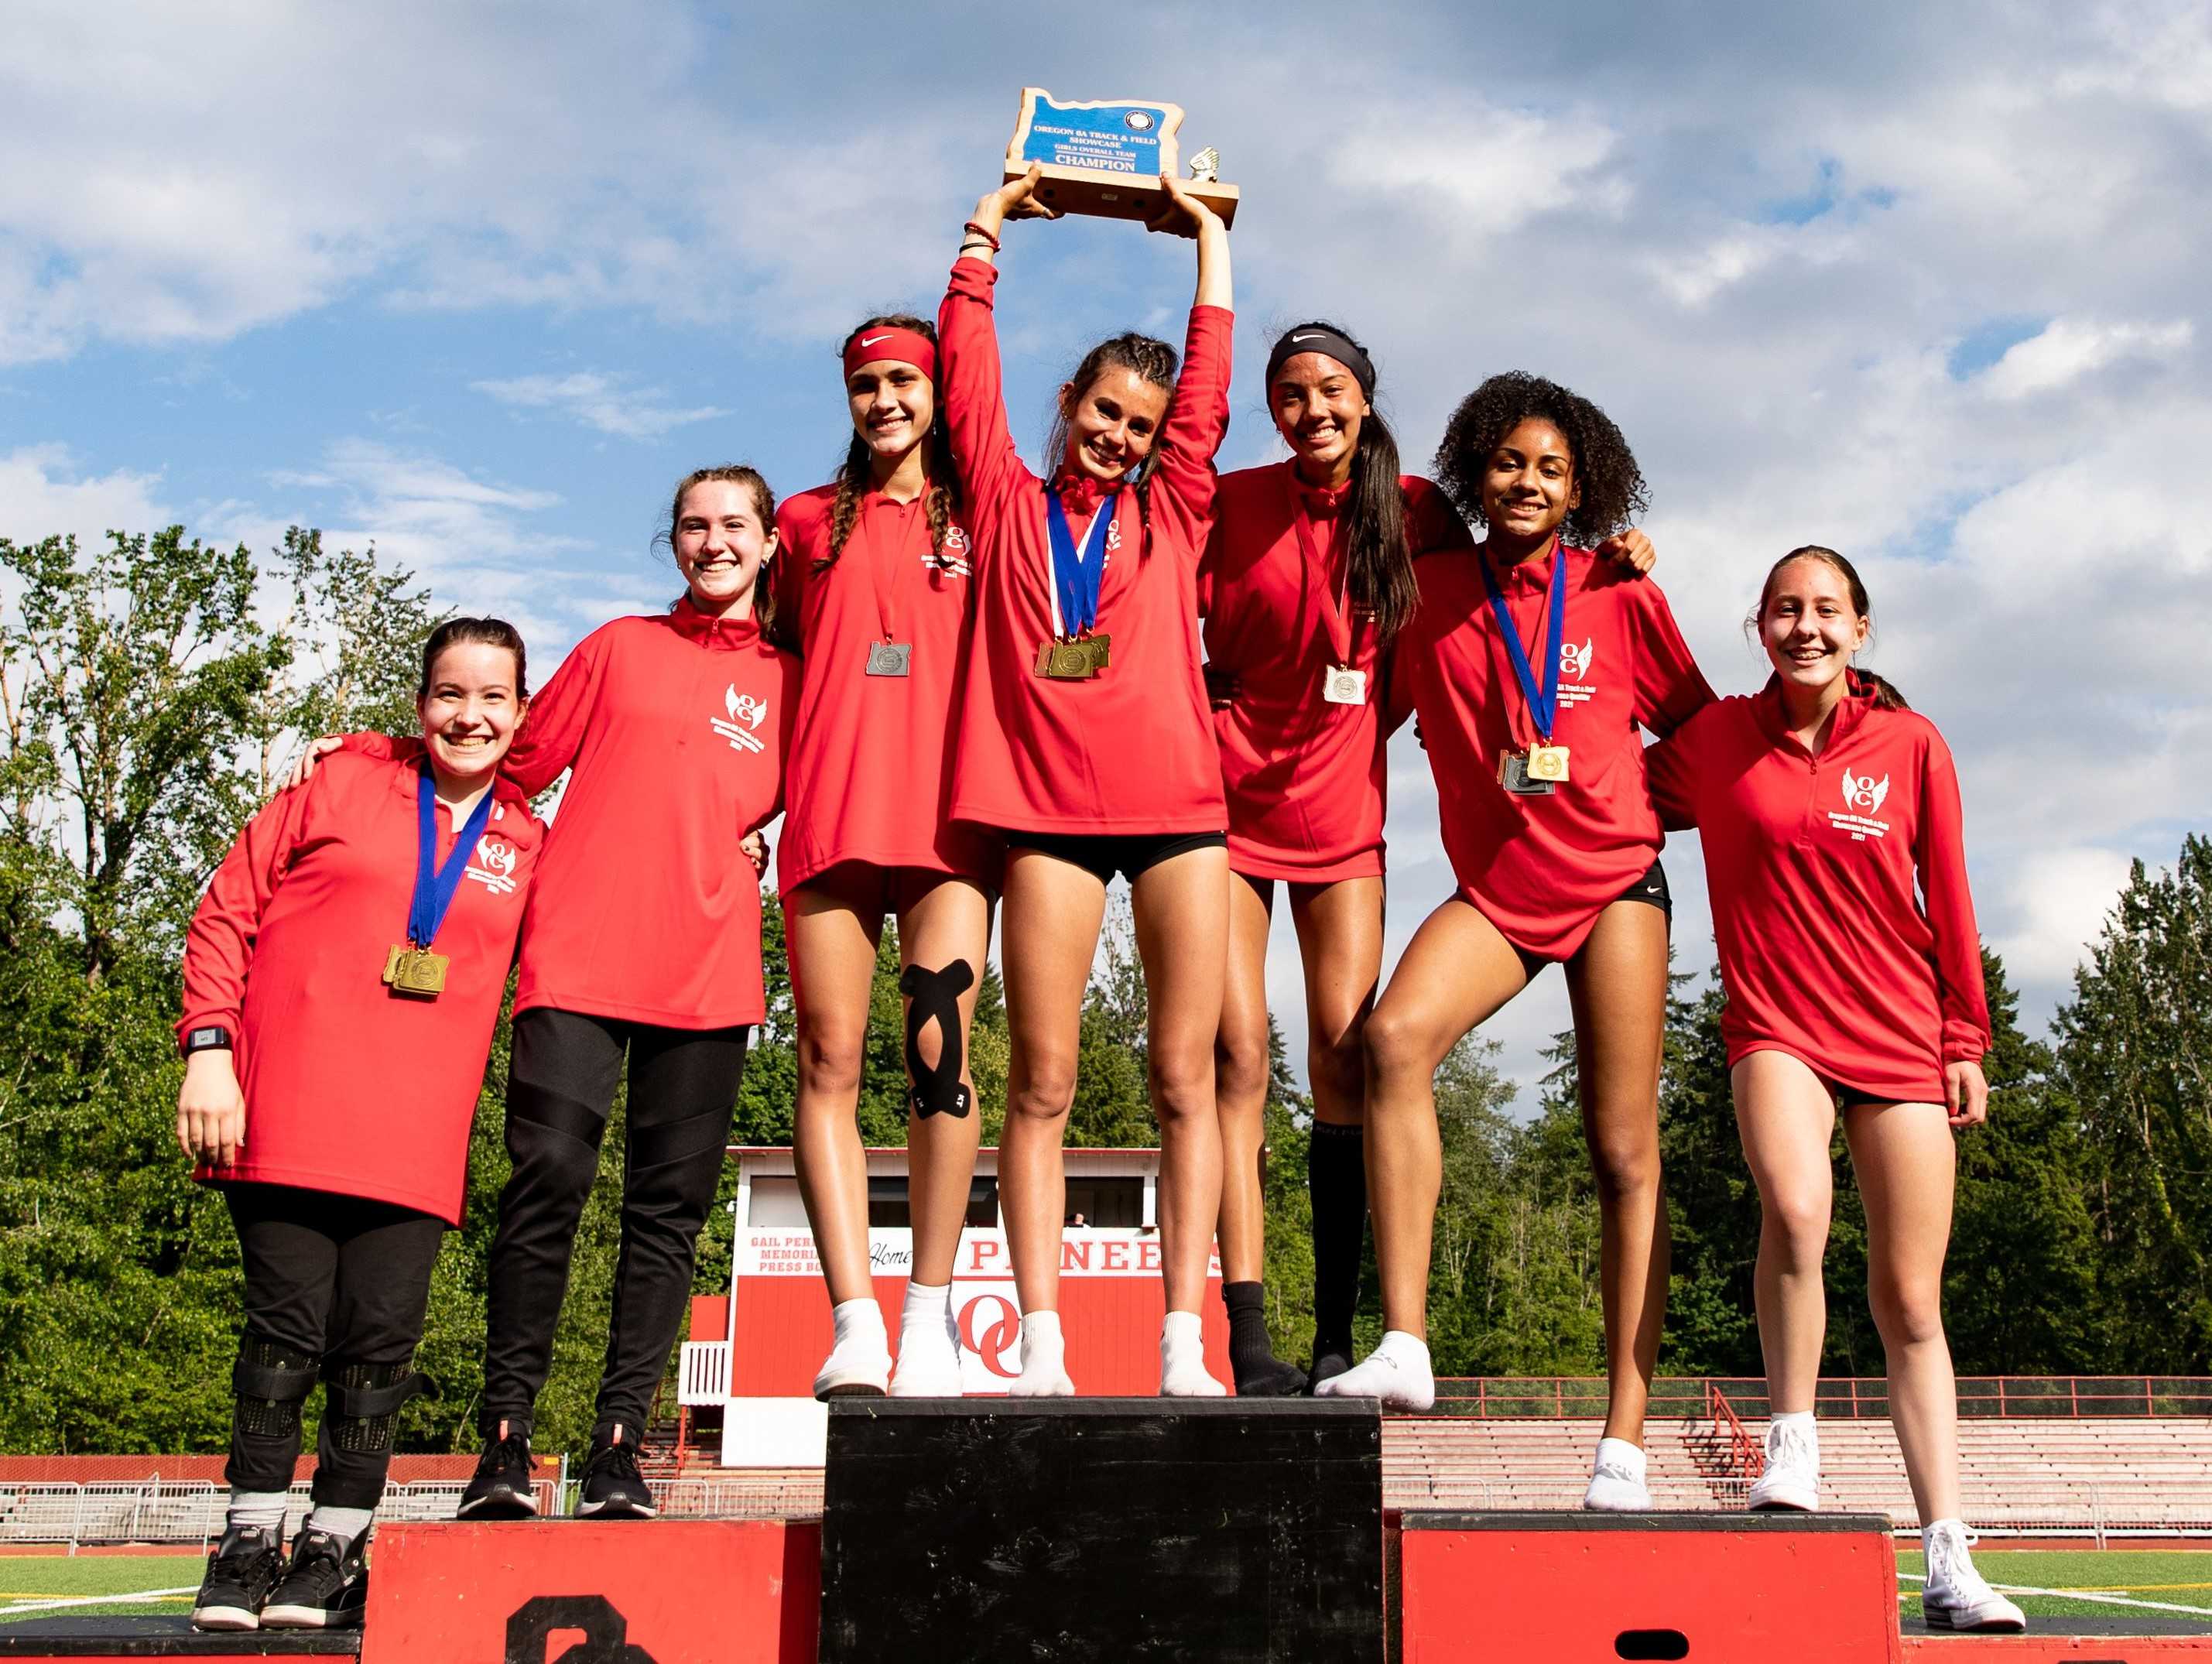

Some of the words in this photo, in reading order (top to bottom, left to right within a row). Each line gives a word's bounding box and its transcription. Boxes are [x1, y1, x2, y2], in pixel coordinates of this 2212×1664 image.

[1034, 125, 1073, 135] OREGON
[1089, 132, 1119, 141] TRACK
[1131, 136, 1157, 146] FIELD
[1069, 136, 1121, 149] SHOWCASE
[1079, 147, 1115, 156] OVERALL
[1055, 155, 1135, 172] CHAMPION
[751, 1238, 780, 1247] GAIL
[785, 1238, 815, 1247] PER
[869, 1242, 913, 1269] Home
[759, 1262, 802, 1272] PRESS
